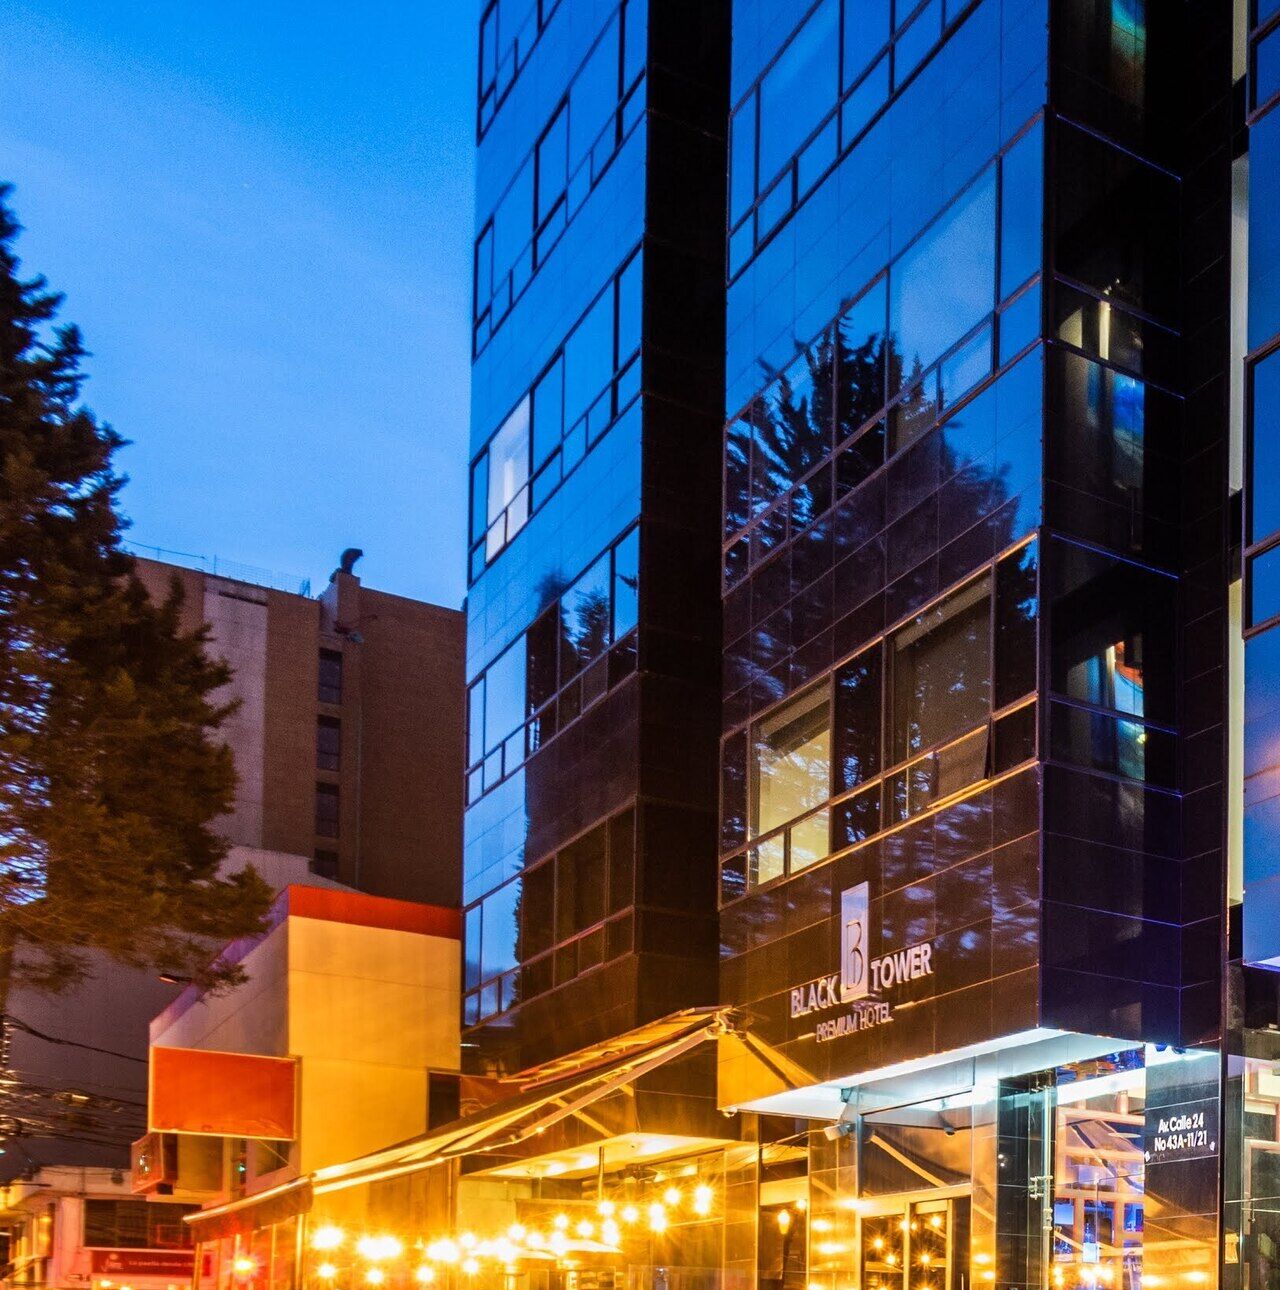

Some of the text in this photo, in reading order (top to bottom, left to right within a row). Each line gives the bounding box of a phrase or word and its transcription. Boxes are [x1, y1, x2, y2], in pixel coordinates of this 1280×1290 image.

[791, 943, 934, 1018] BLACK TOWER
[816, 1002, 894, 1043] PREMIUM HOTEL
[1170, 1115, 1192, 1132] Calle
[1192, 1112, 1204, 1128] 24
[1154, 1137, 1166, 1152] No
